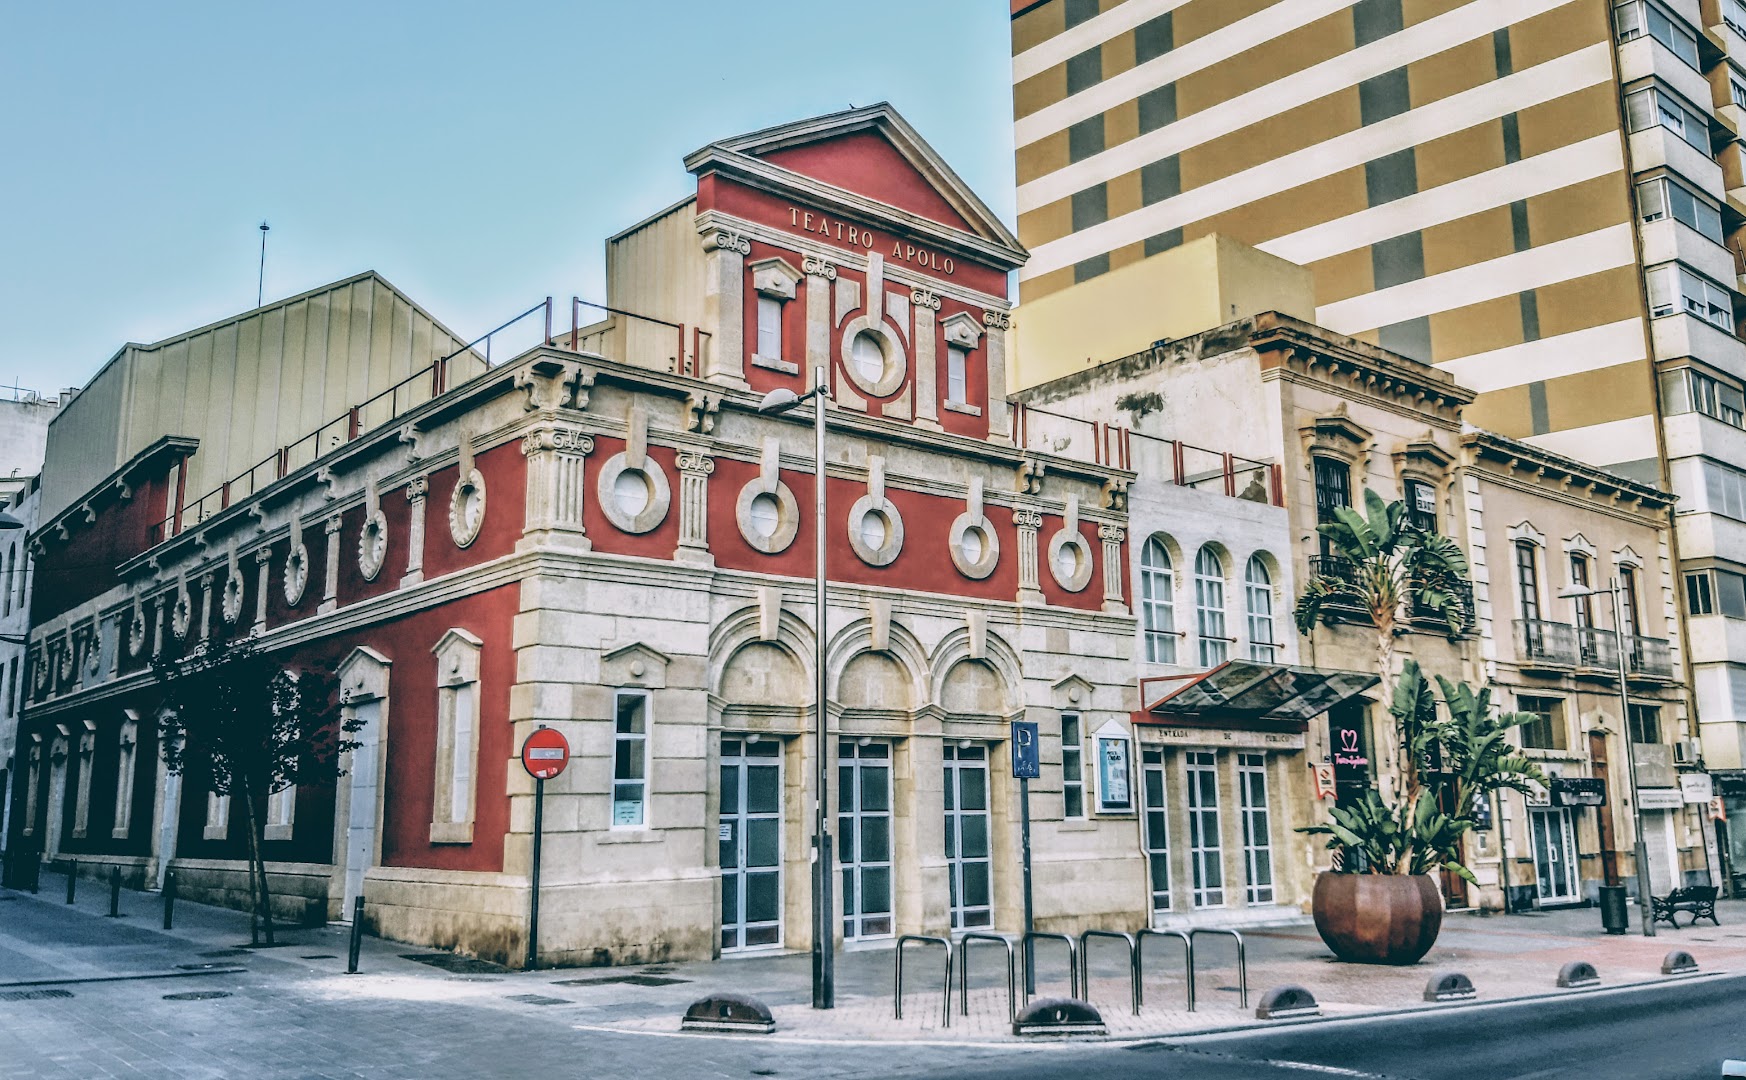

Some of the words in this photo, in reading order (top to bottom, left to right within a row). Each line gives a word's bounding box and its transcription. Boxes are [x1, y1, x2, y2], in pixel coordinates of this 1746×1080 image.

[789, 207, 873, 249] TEATRO
[892, 242, 954, 275] APOLO
[1017, 729, 1032, 758] P
[1159, 729, 1188, 738] ENTRADA
